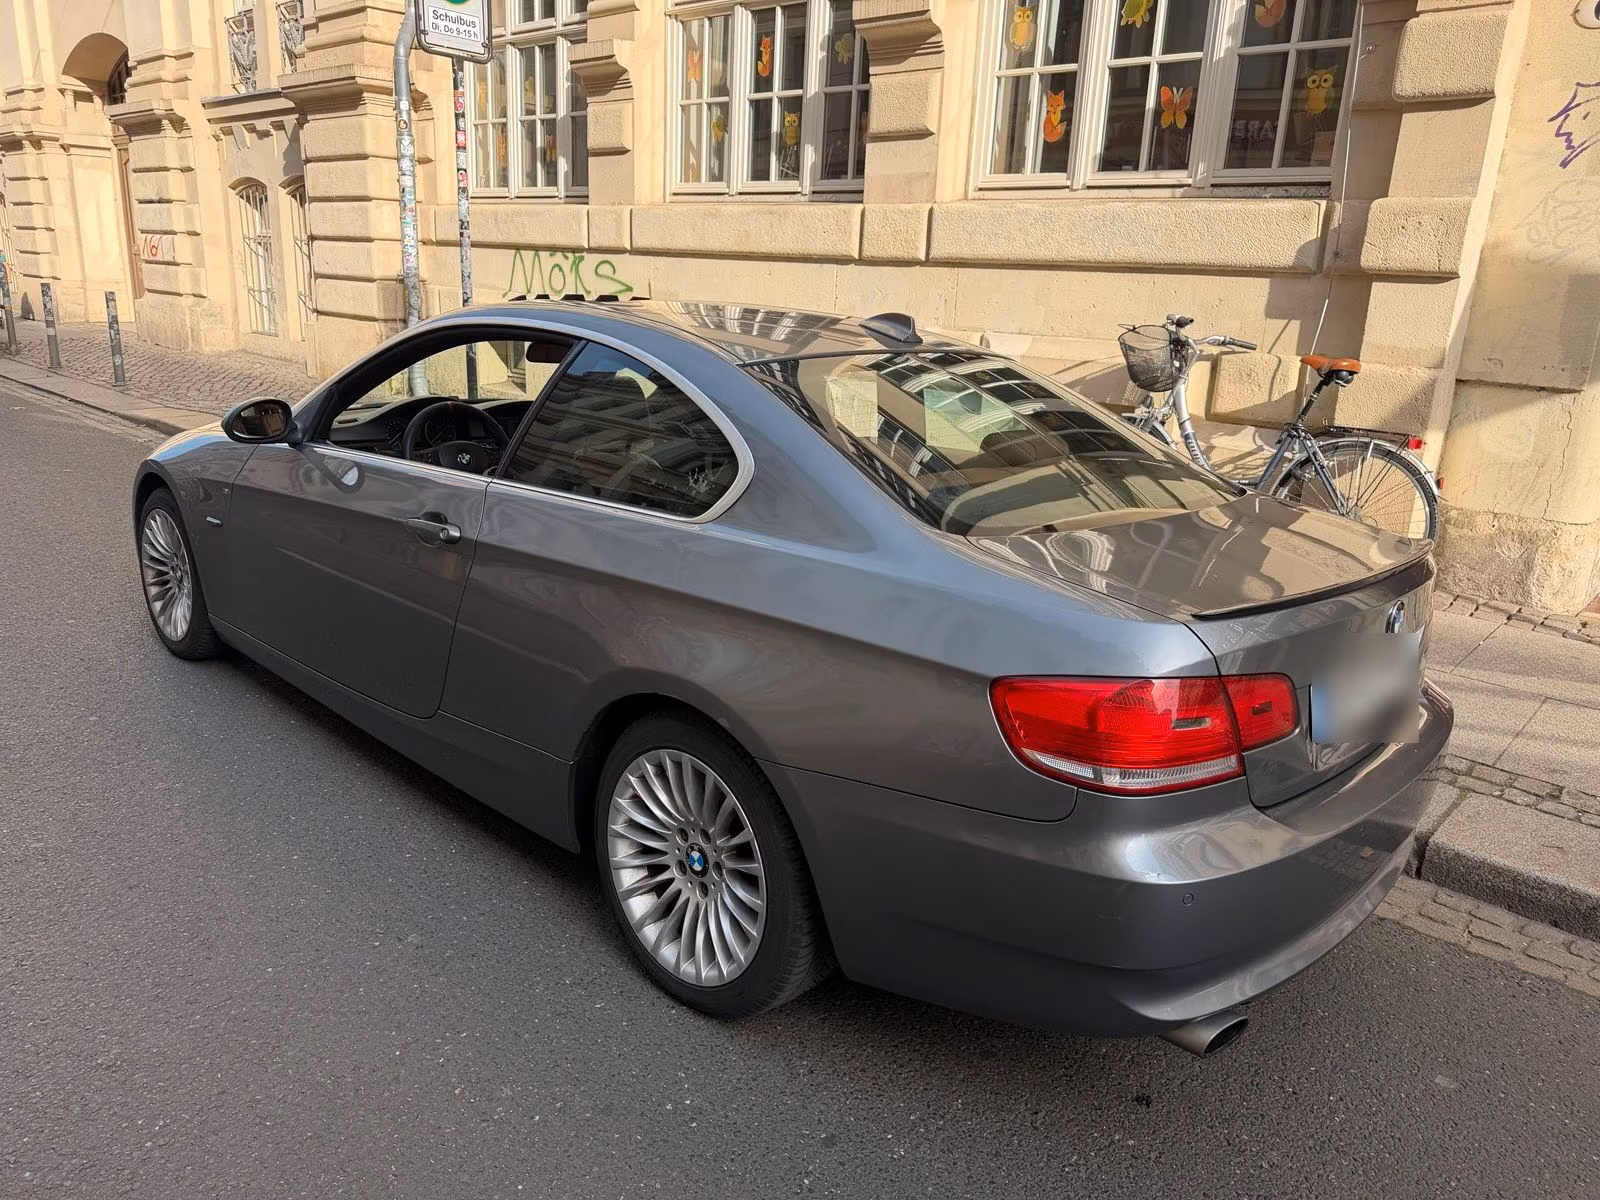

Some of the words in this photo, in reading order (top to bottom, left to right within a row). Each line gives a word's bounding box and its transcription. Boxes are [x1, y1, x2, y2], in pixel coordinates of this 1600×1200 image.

[432, 9, 477, 29] Schulbus
[443, 24, 455, 34] Do
[455, 27, 472, 38] 9-15
[473, 31, 479, 39] h
